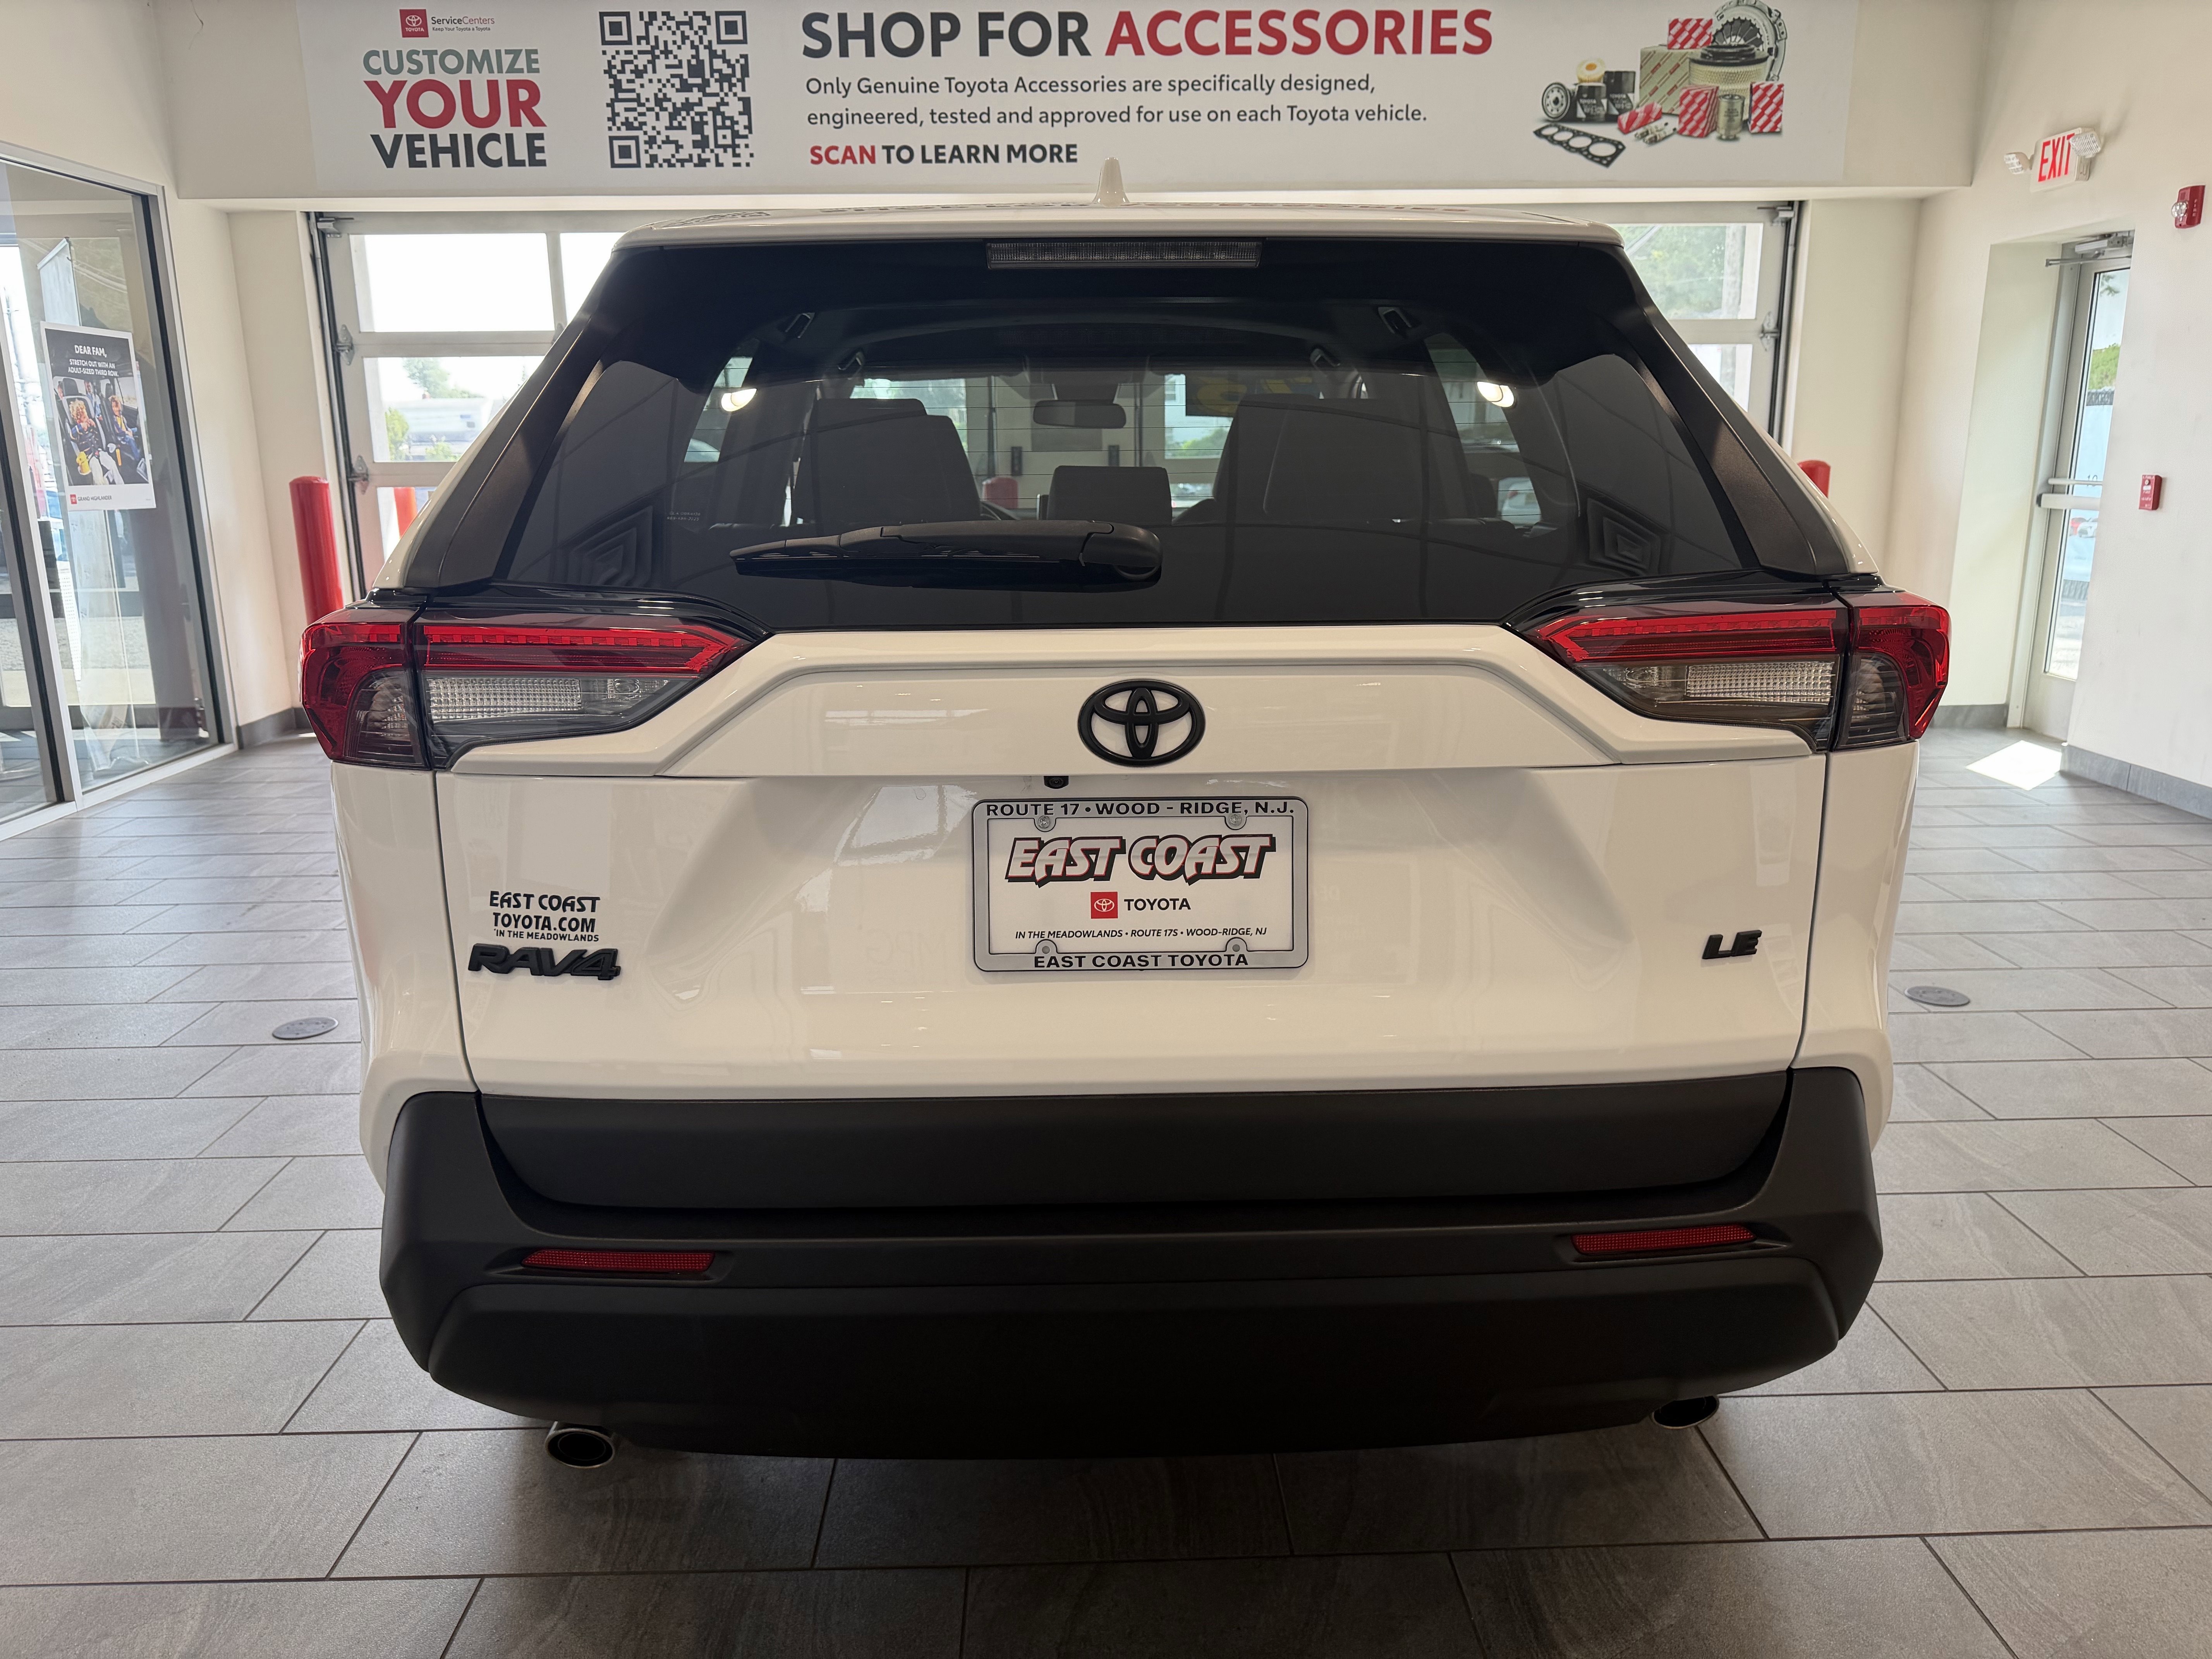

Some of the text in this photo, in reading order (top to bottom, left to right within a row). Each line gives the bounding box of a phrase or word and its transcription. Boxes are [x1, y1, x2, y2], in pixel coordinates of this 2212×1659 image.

[431, 16, 495, 24] ServiceCenters
[802, 9, 1492, 58] SHOP FOR ACCESSORIES
[363, 49, 540, 75] CUSTOMIZE
[806, 74, 1374, 98] Only Genuine Toyota Accessories are specifically designed,
[364, 79, 546, 129] YOUR
[808, 104, 1426, 129] engineered, tested and approved for use on each Toyota vehicle.
[370, 133, 546, 168] VEHICLE
[811, 144, 1077, 165] SCAN TO LEARN MORE
[2038, 133, 2075, 182] EXIT
[74, 345, 107, 358] DEAR FAM,
[987, 804, 1054, 816] ROUTE
[1061, 804, 1079, 815] 17
[1096, 803, 1160, 815] WOOD
[1180, 802, 1248, 815] RIDGE,
[1255, 802, 1293, 813] N.J.
[1005, 834, 1276, 888] EAST COAST
[490, 891, 600, 912] EAST COAST
[1124, 898, 1191, 910] TOYOTA
[493, 912, 596, 933] TOYOTA.COM
[1027, 931, 1046, 939] THE
[1047, 930, 1123, 939] MEADOWLANDS
[1187, 928, 1252, 938] WOOD-RIDGE,
[507, 930, 524, 938] THE
[527, 932, 599, 942] MEADOWLANDS
[1702, 929, 1762, 959] LE
[468, 943, 621, 981] RAV4
[1034, 953, 1248, 968] EAST COAST TOYOTA
